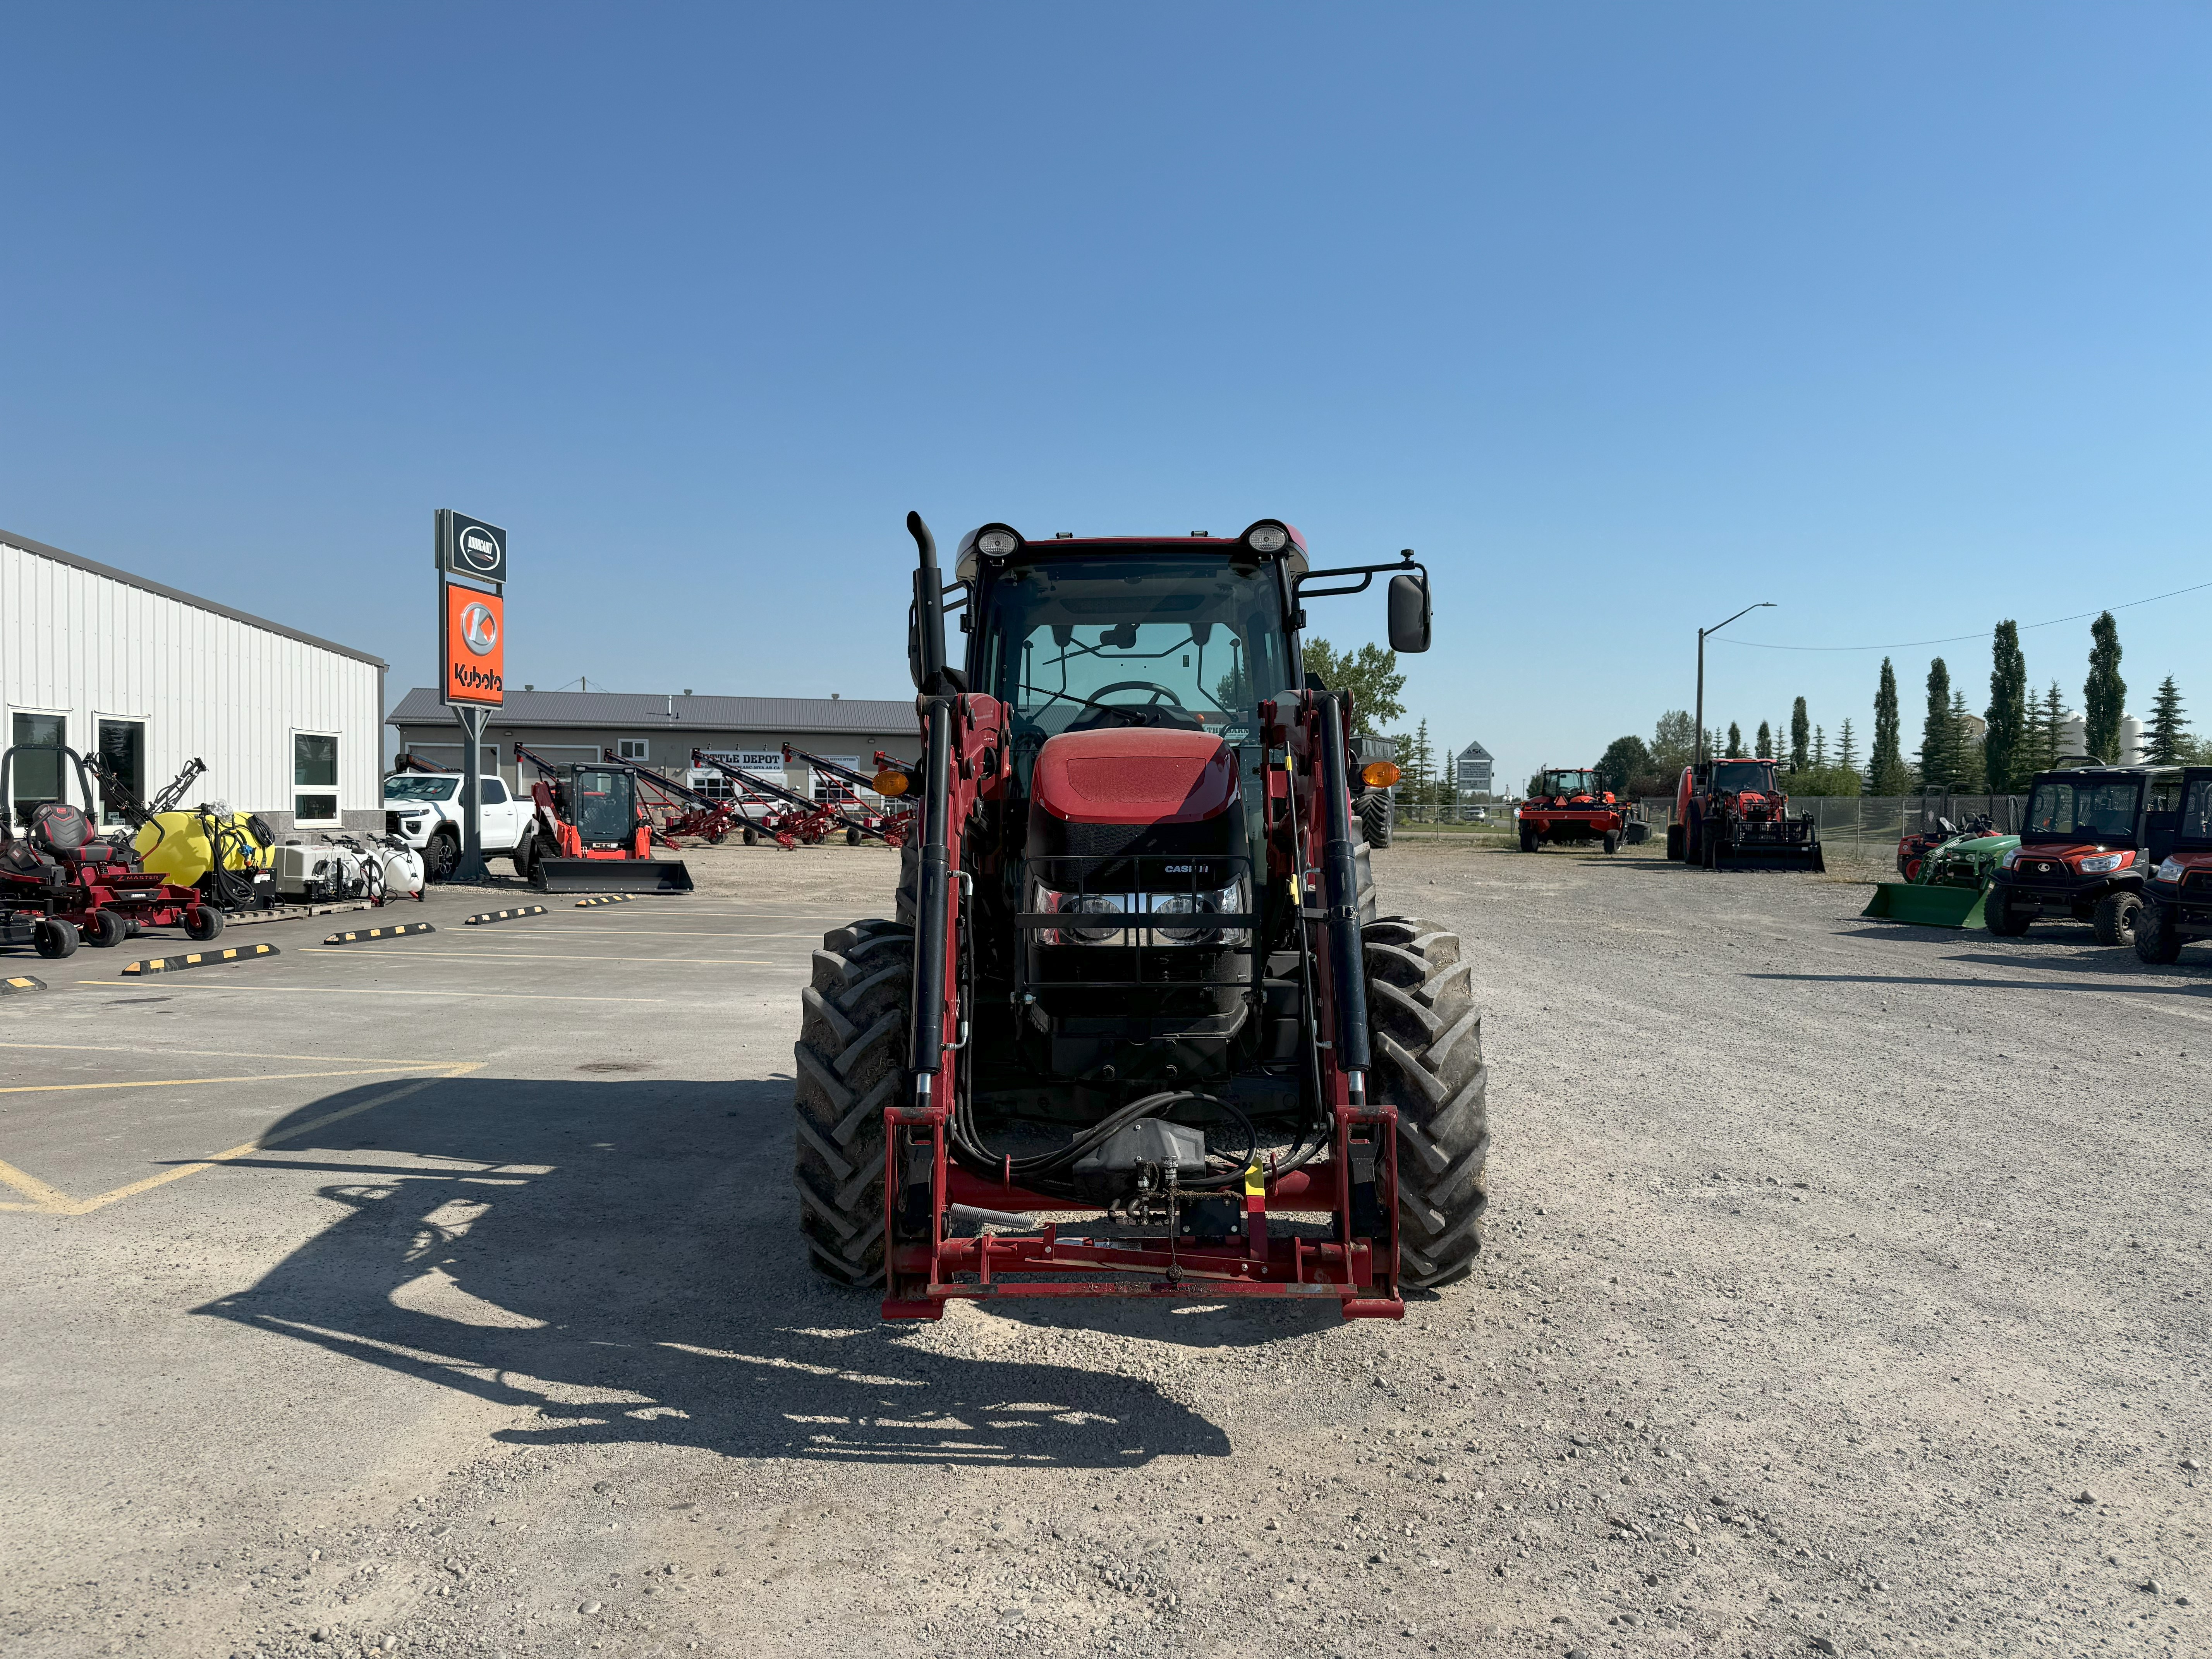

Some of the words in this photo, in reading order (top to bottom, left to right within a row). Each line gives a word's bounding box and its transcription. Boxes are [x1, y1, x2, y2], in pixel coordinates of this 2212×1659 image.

[468, 536, 493, 555] BOURGAULT
[455, 663, 502, 691] Kubota
[743, 754, 780, 764] DEPOT
